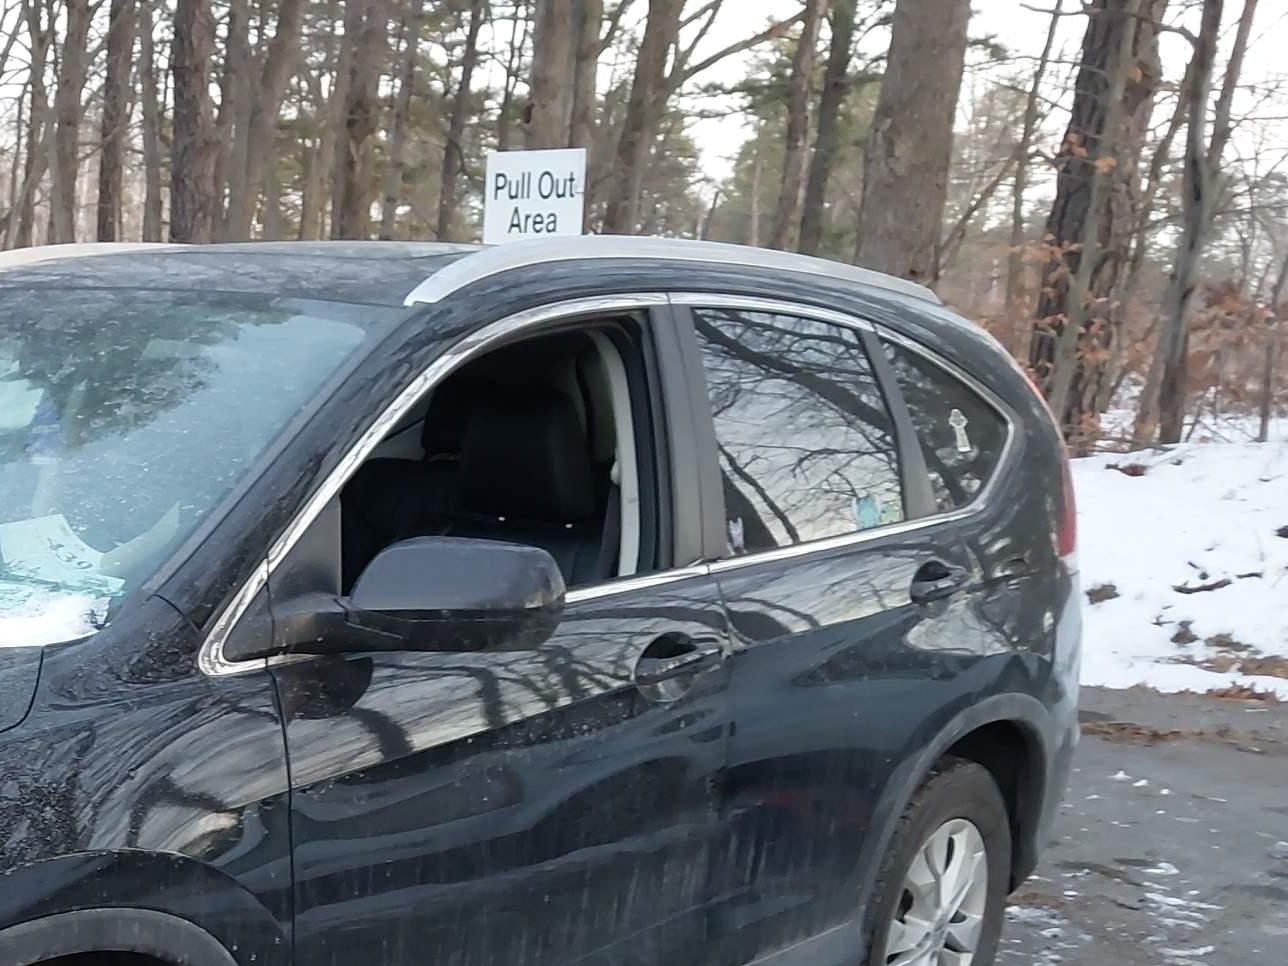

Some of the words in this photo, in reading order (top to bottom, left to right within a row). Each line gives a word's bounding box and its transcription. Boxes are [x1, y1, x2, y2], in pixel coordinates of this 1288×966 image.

[494, 171, 531, 200] Pull
[538, 170, 576, 199] Out
[507, 206, 558, 234] Area
